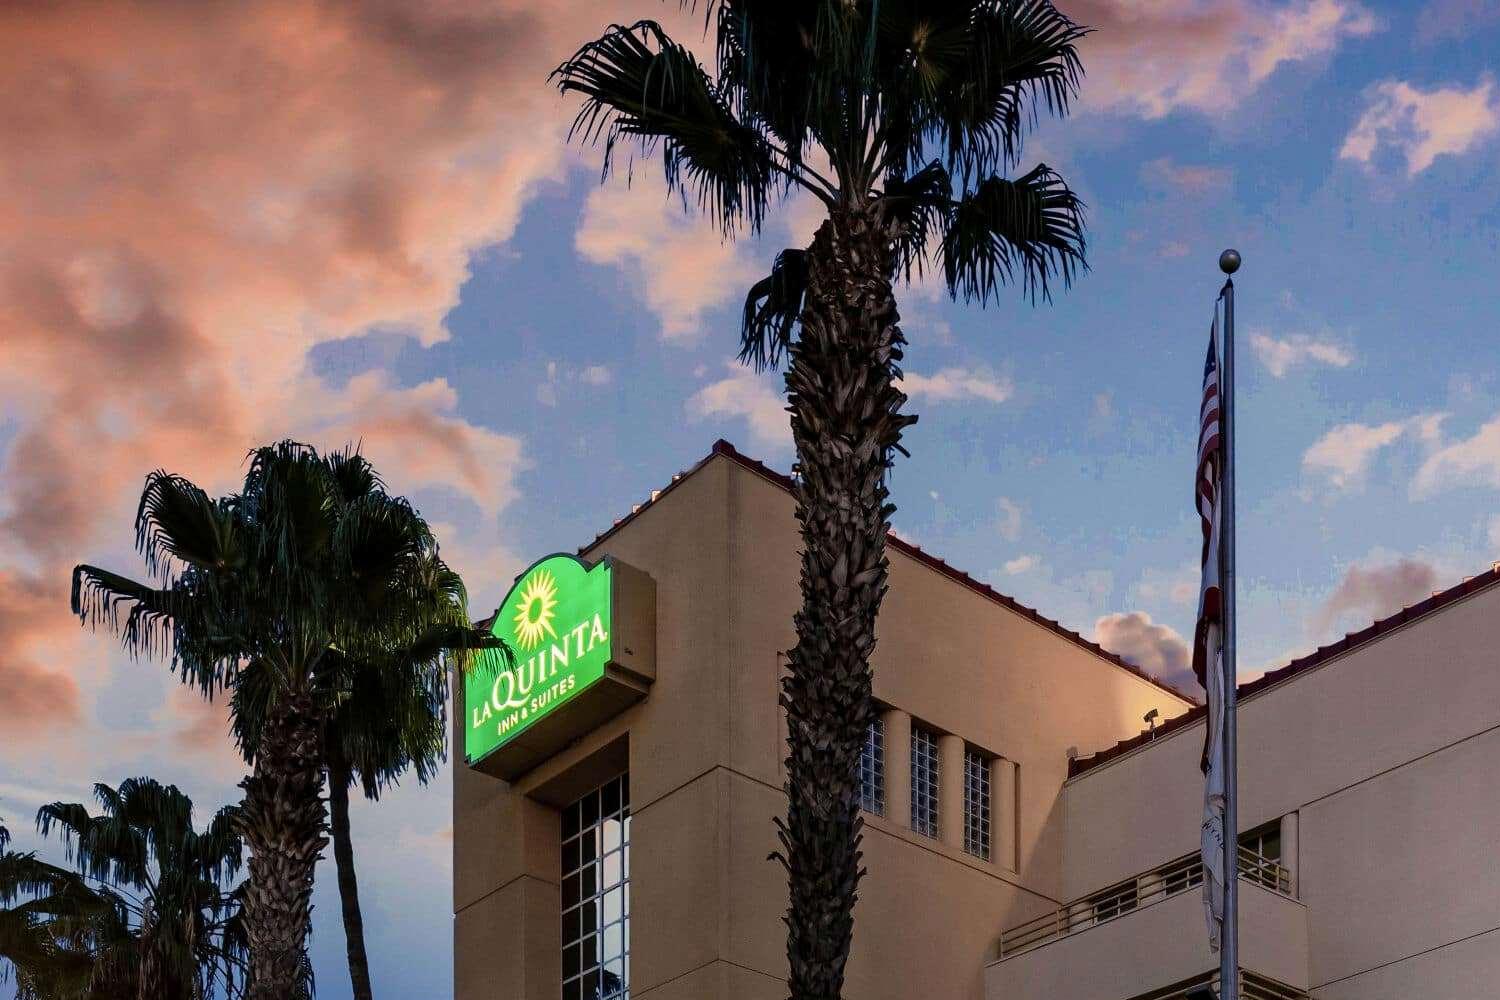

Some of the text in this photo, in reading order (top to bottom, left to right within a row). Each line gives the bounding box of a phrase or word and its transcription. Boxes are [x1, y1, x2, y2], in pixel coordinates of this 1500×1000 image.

[473, 613, 608, 728] LA QUINTA
[498, 674, 576, 736] INN & SUITES
